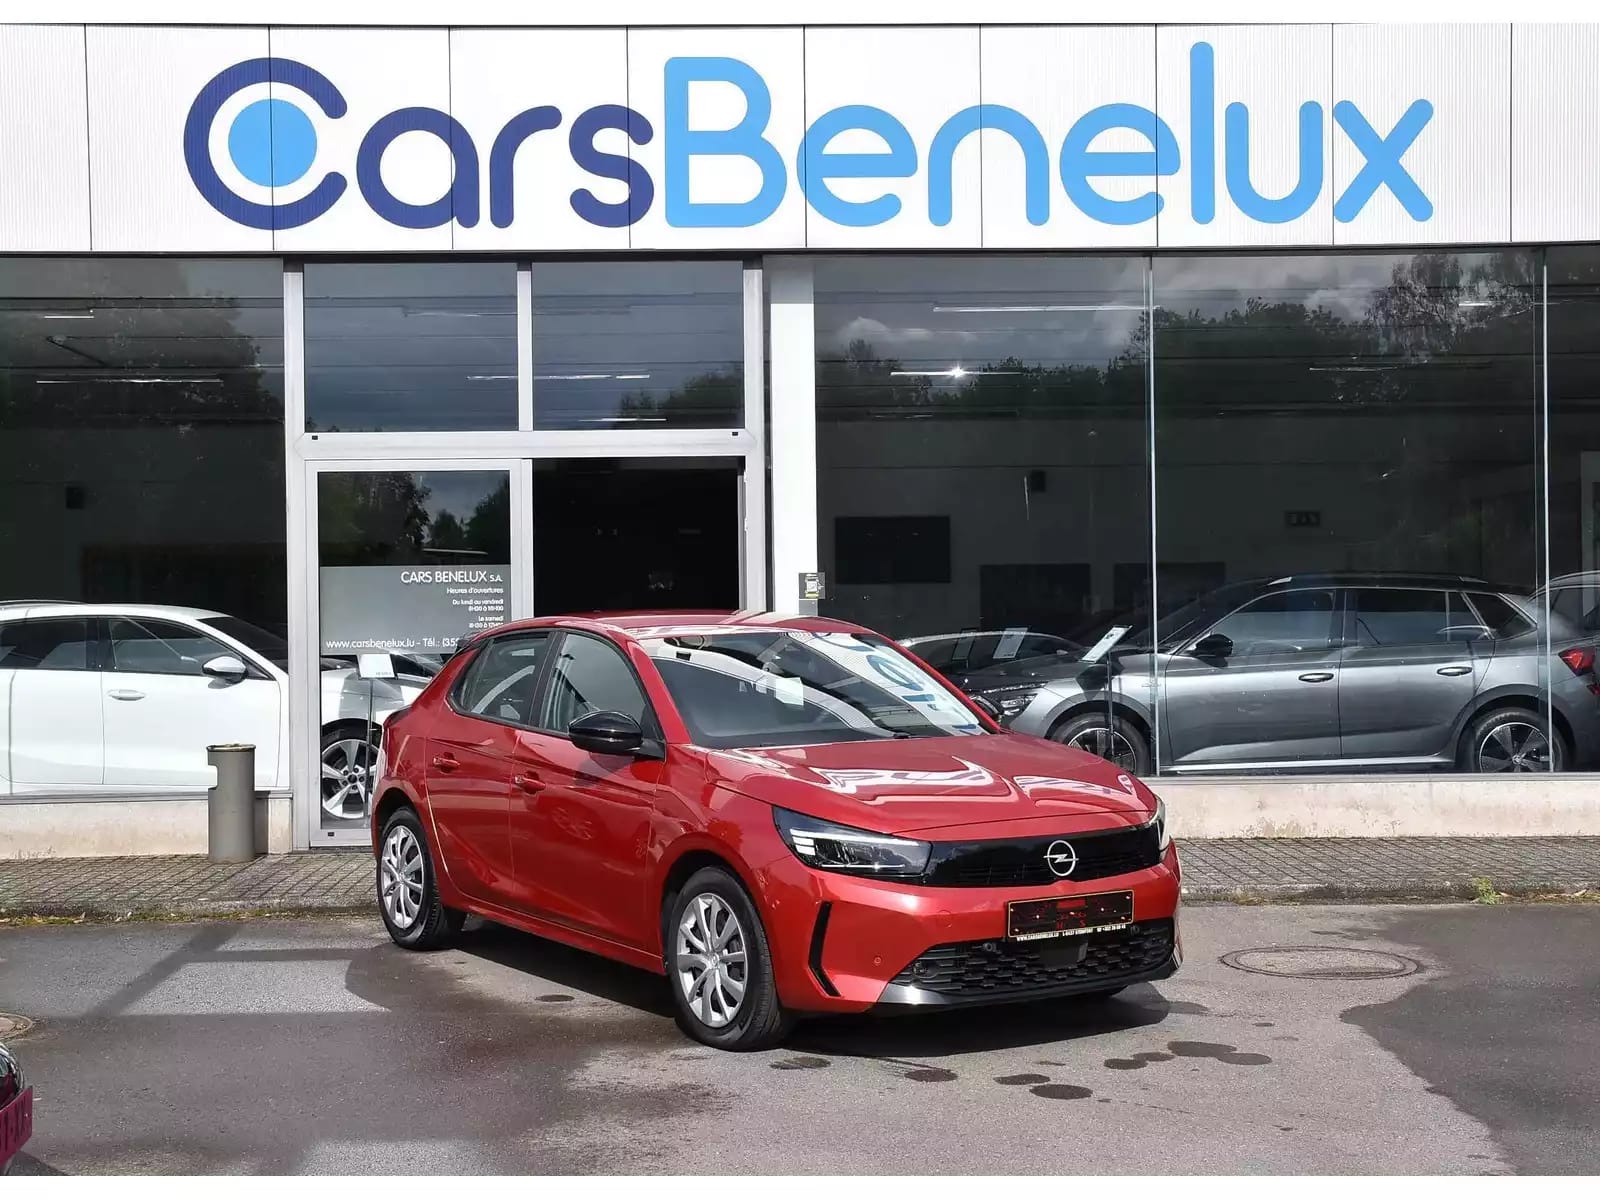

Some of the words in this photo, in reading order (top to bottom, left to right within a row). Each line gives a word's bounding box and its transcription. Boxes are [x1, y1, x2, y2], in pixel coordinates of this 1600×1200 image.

[185, 41, 1434, 229] CarsBenelux
[400, 571, 432, 583] CARS
[435, 570, 487, 583] BENELUX
[326, 637, 415, 649] www.carsbenelux.lu
